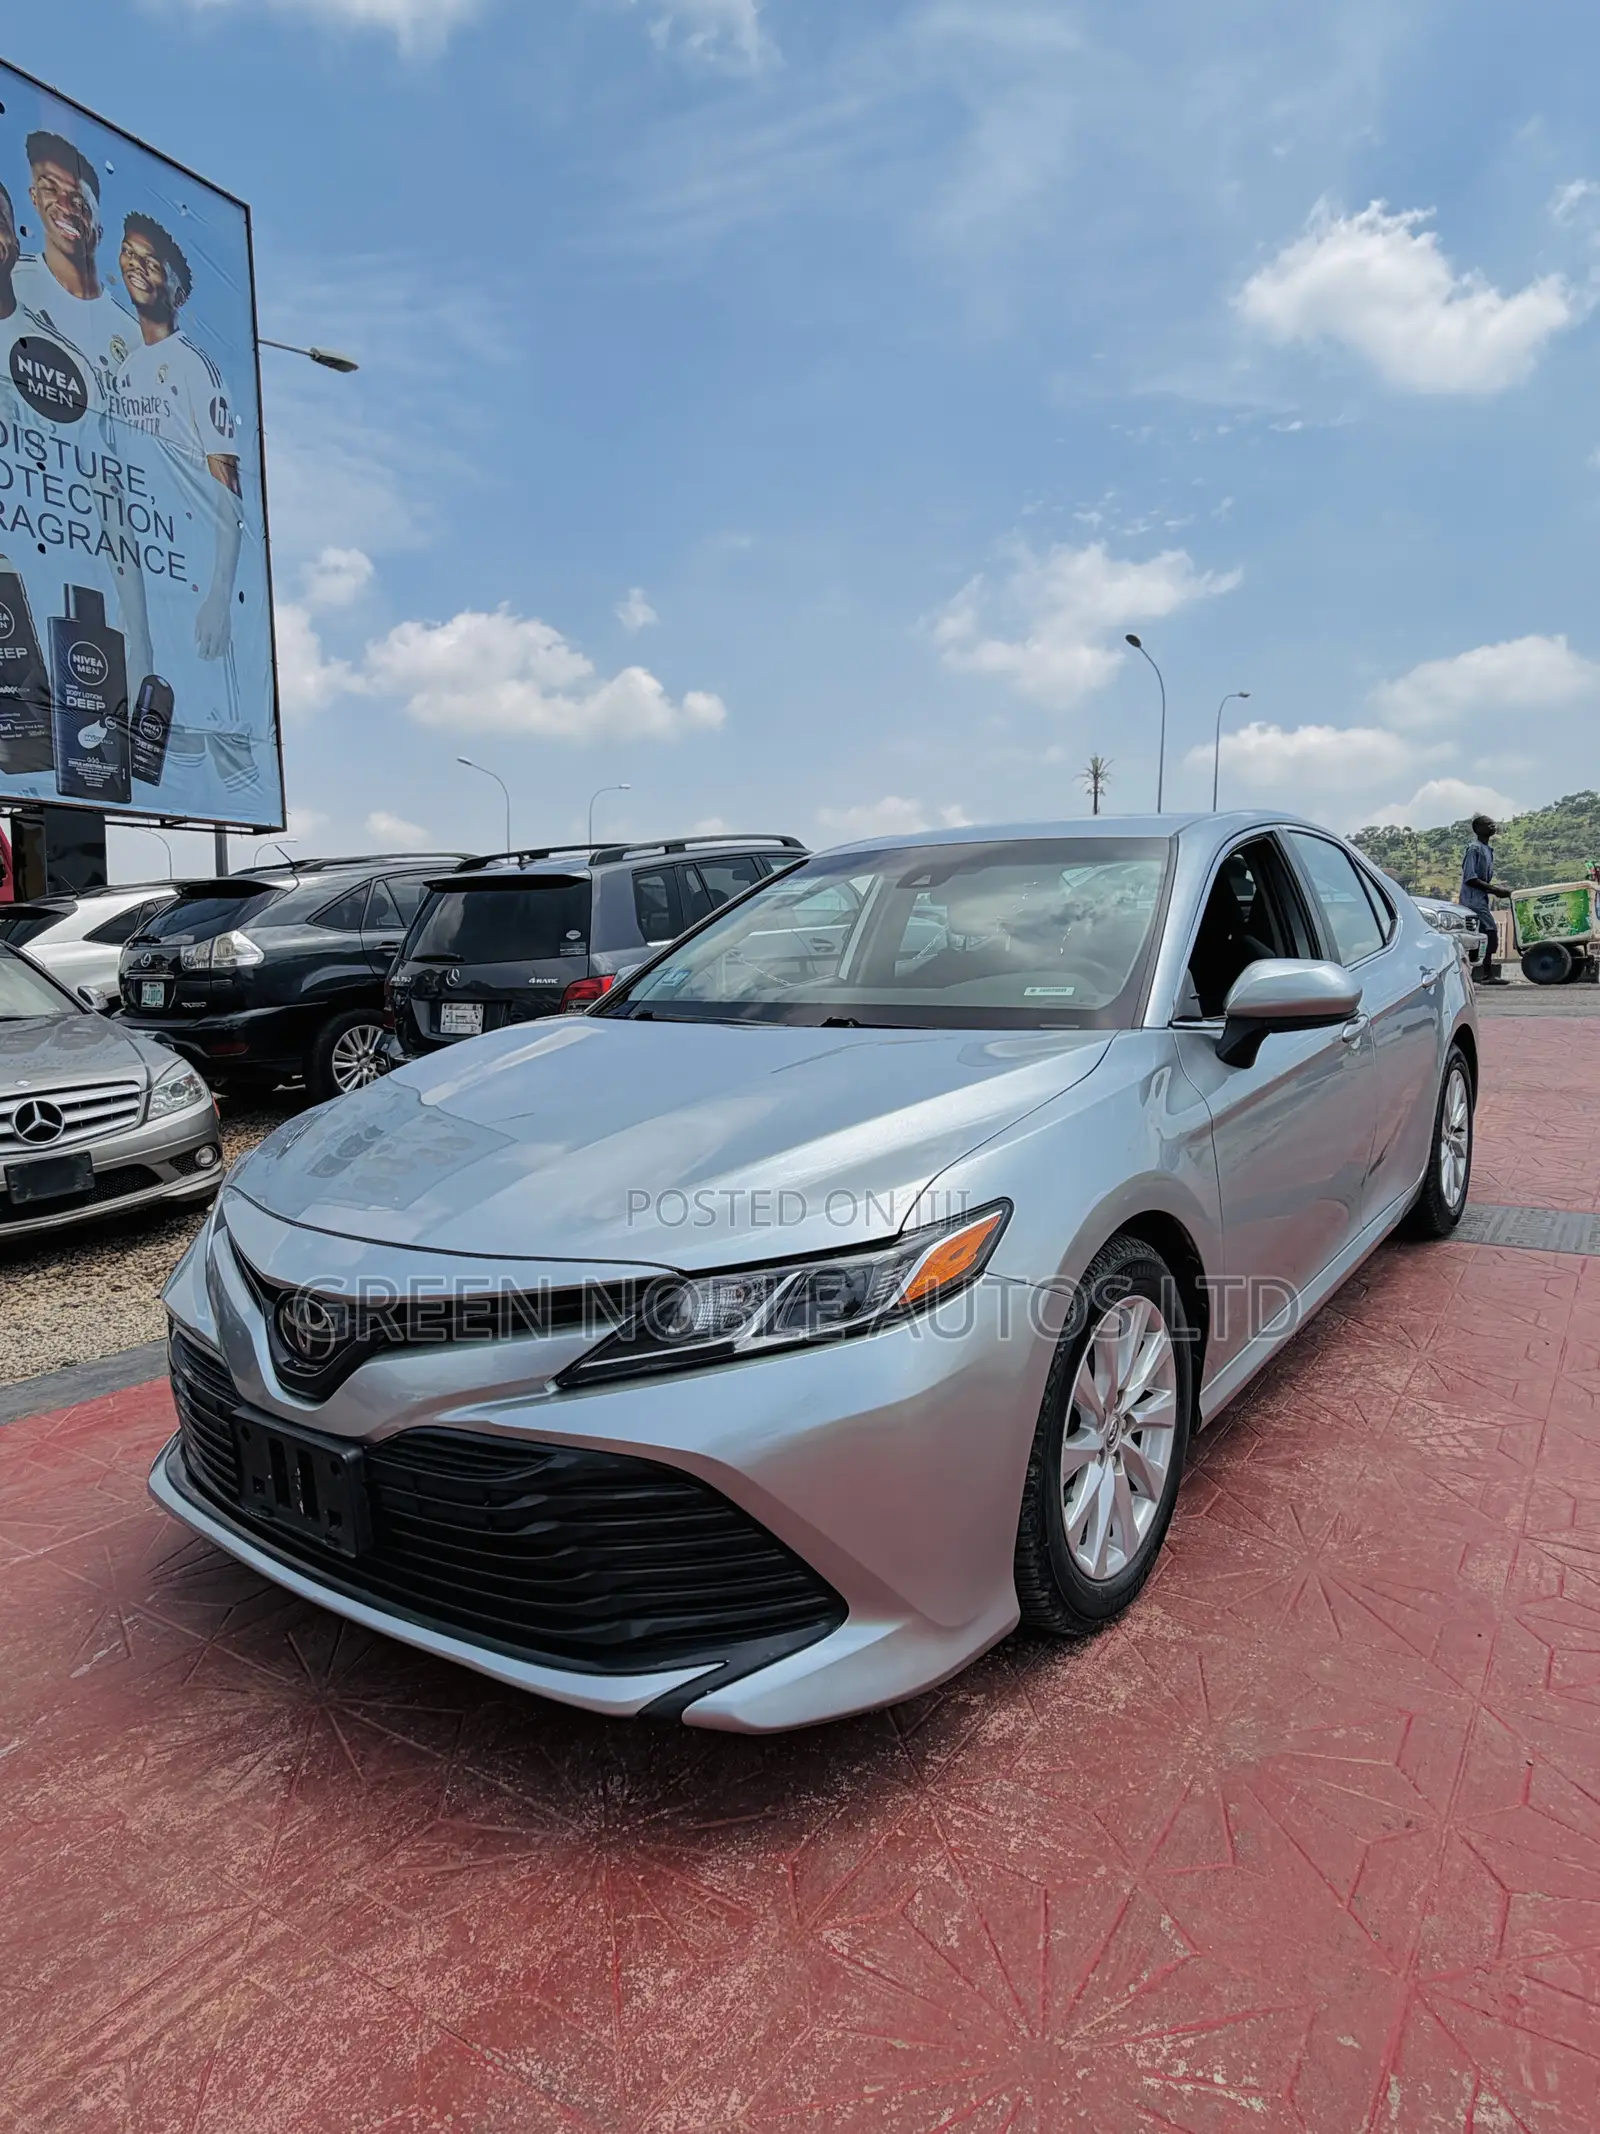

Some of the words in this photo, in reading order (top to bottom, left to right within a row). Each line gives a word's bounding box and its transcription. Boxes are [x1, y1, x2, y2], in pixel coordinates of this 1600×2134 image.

[17, 354, 81, 396] NIVEA
[27, 378, 74, 409] MEN
[72, 654, 104, 669] NIVEA
[77, 664, 100, 676] MEN
[66, 696, 106, 711] DEEP
